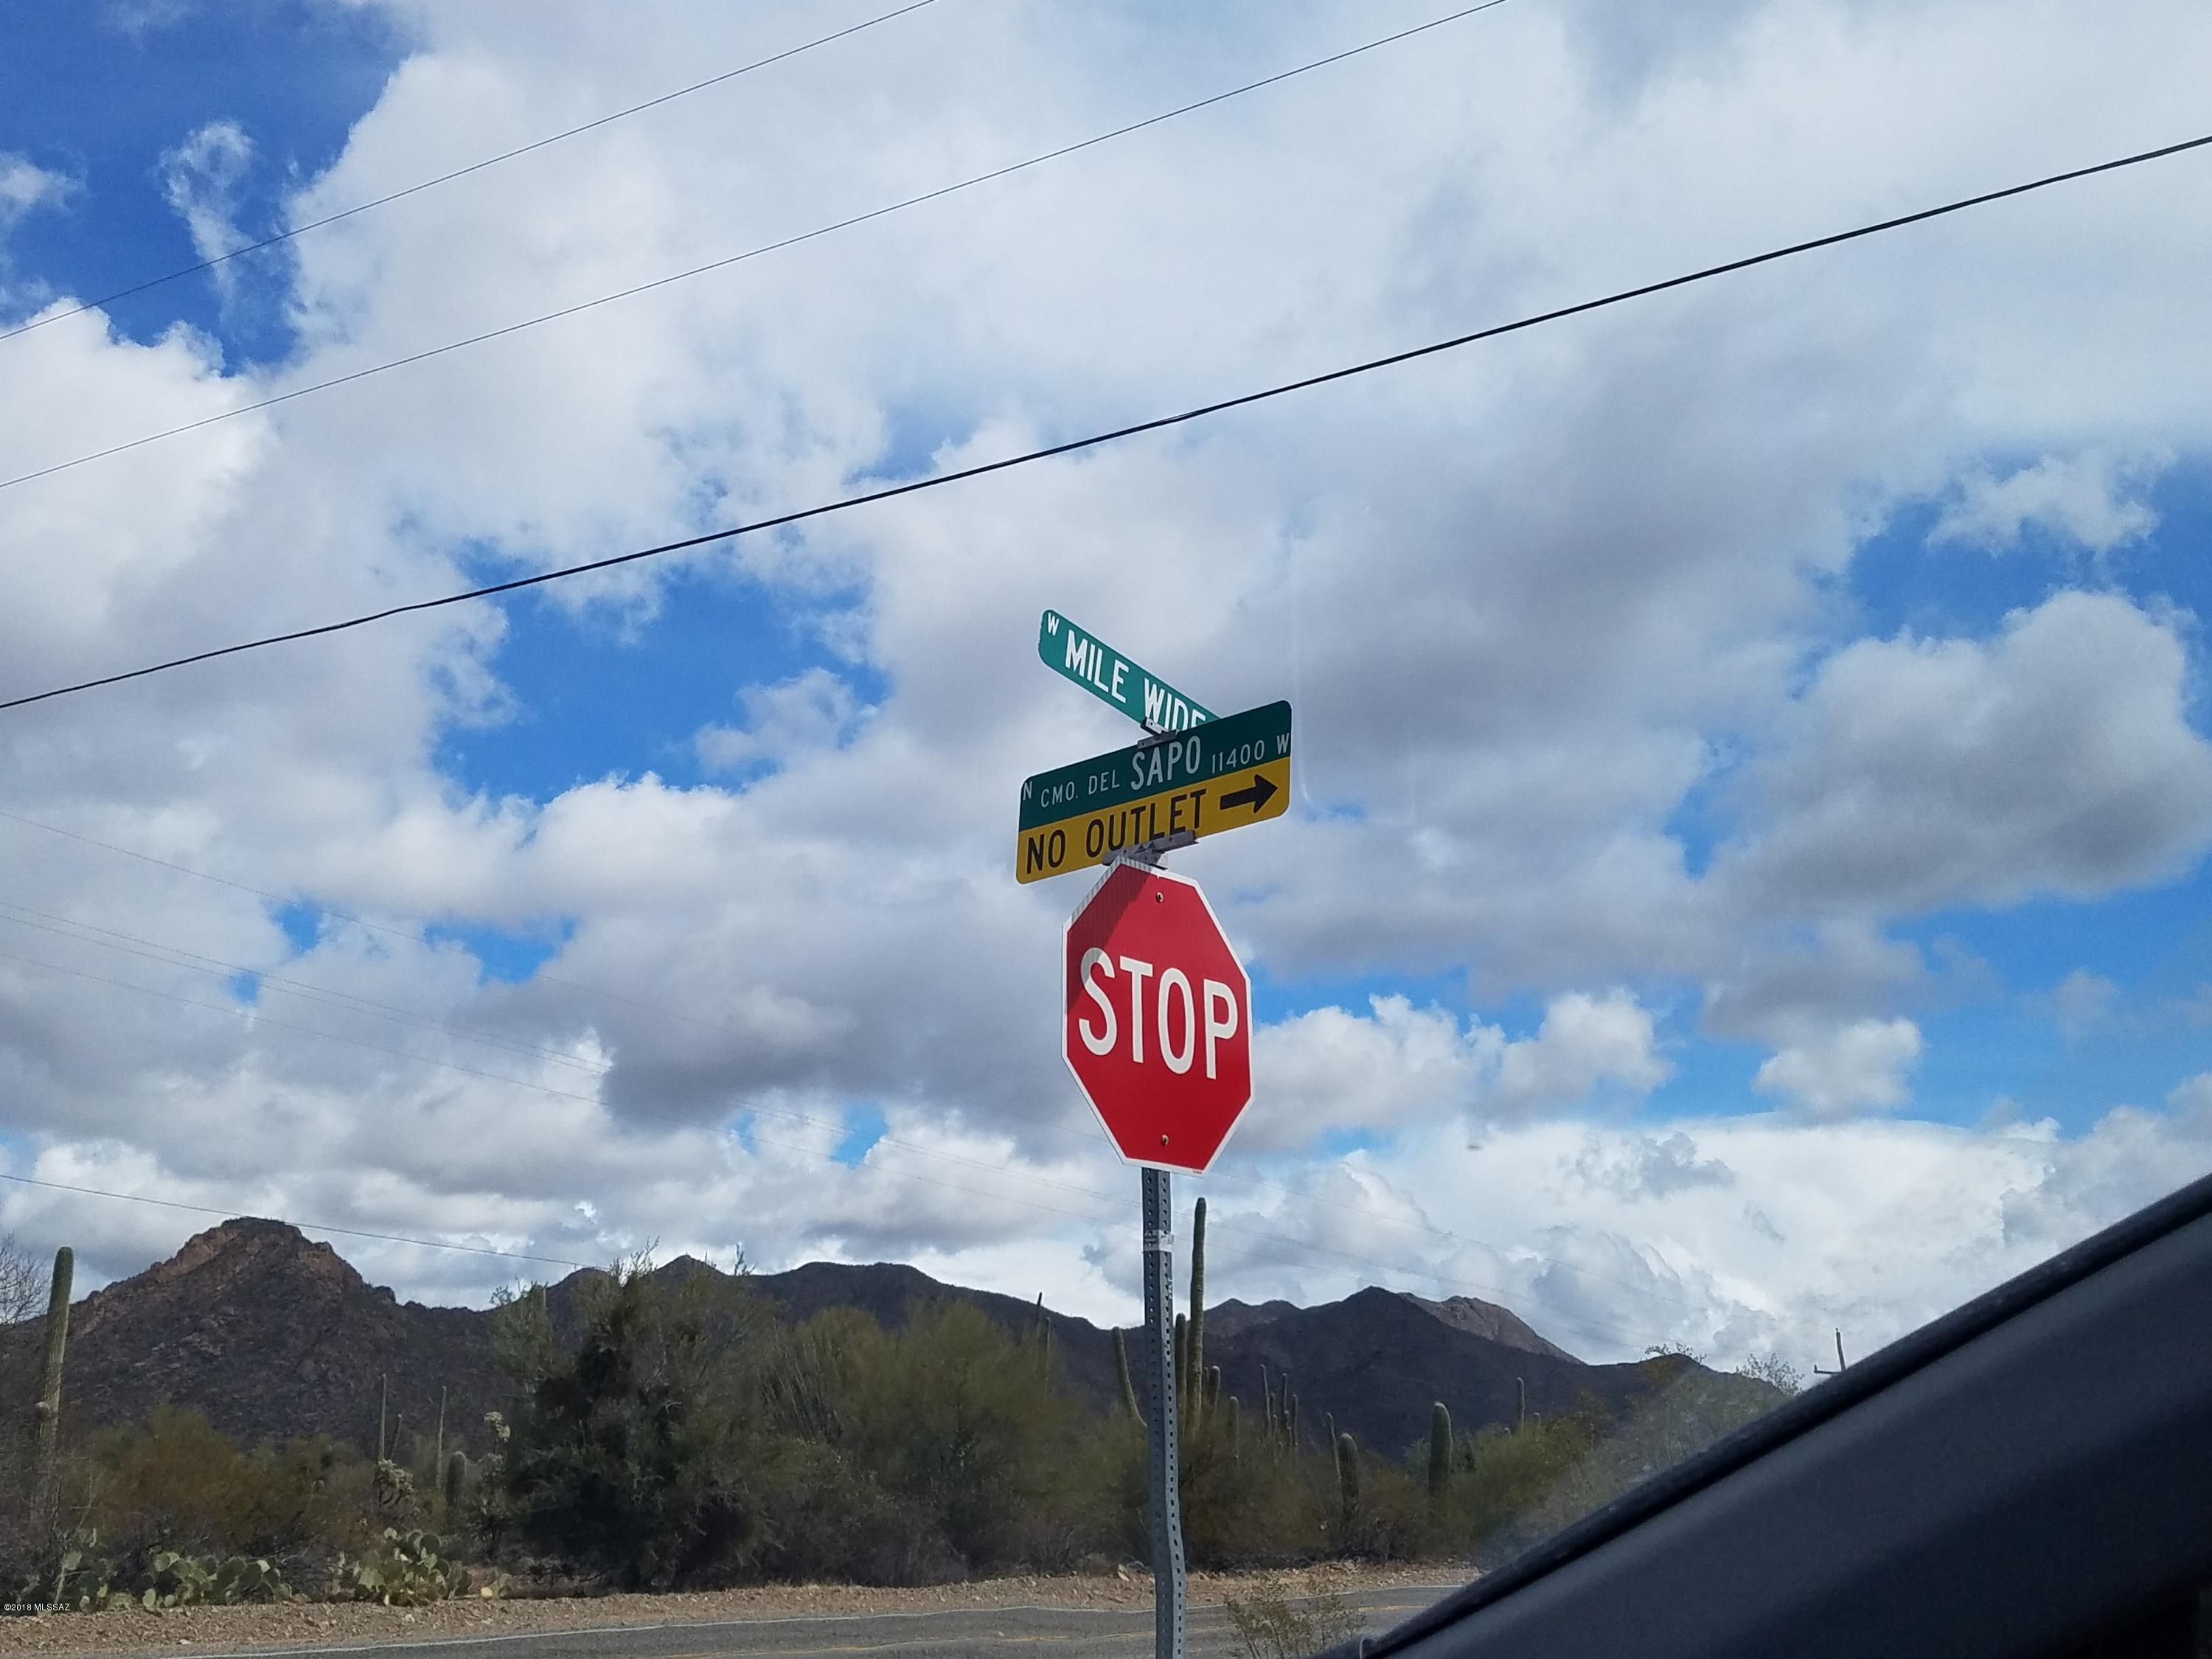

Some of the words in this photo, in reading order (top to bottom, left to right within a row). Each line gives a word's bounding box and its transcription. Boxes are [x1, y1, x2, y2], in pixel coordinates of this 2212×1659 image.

[1048, 612, 1060, 636] W
[1065, 628, 1130, 704] MILE
[1023, 780, 1032, 801] N
[1040, 781, 1078, 808] CMO.
[1088, 769, 1120, 795] DEL
[1130, 736, 1201, 790] SAPO
[1211, 740, 1265, 773] 11400
[1276, 732, 1290, 755] W
[1026, 830, 1065, 874] NO
[1086, 788, 1207, 858] OUTLET
[1079, 947, 1239, 1080] STOP
